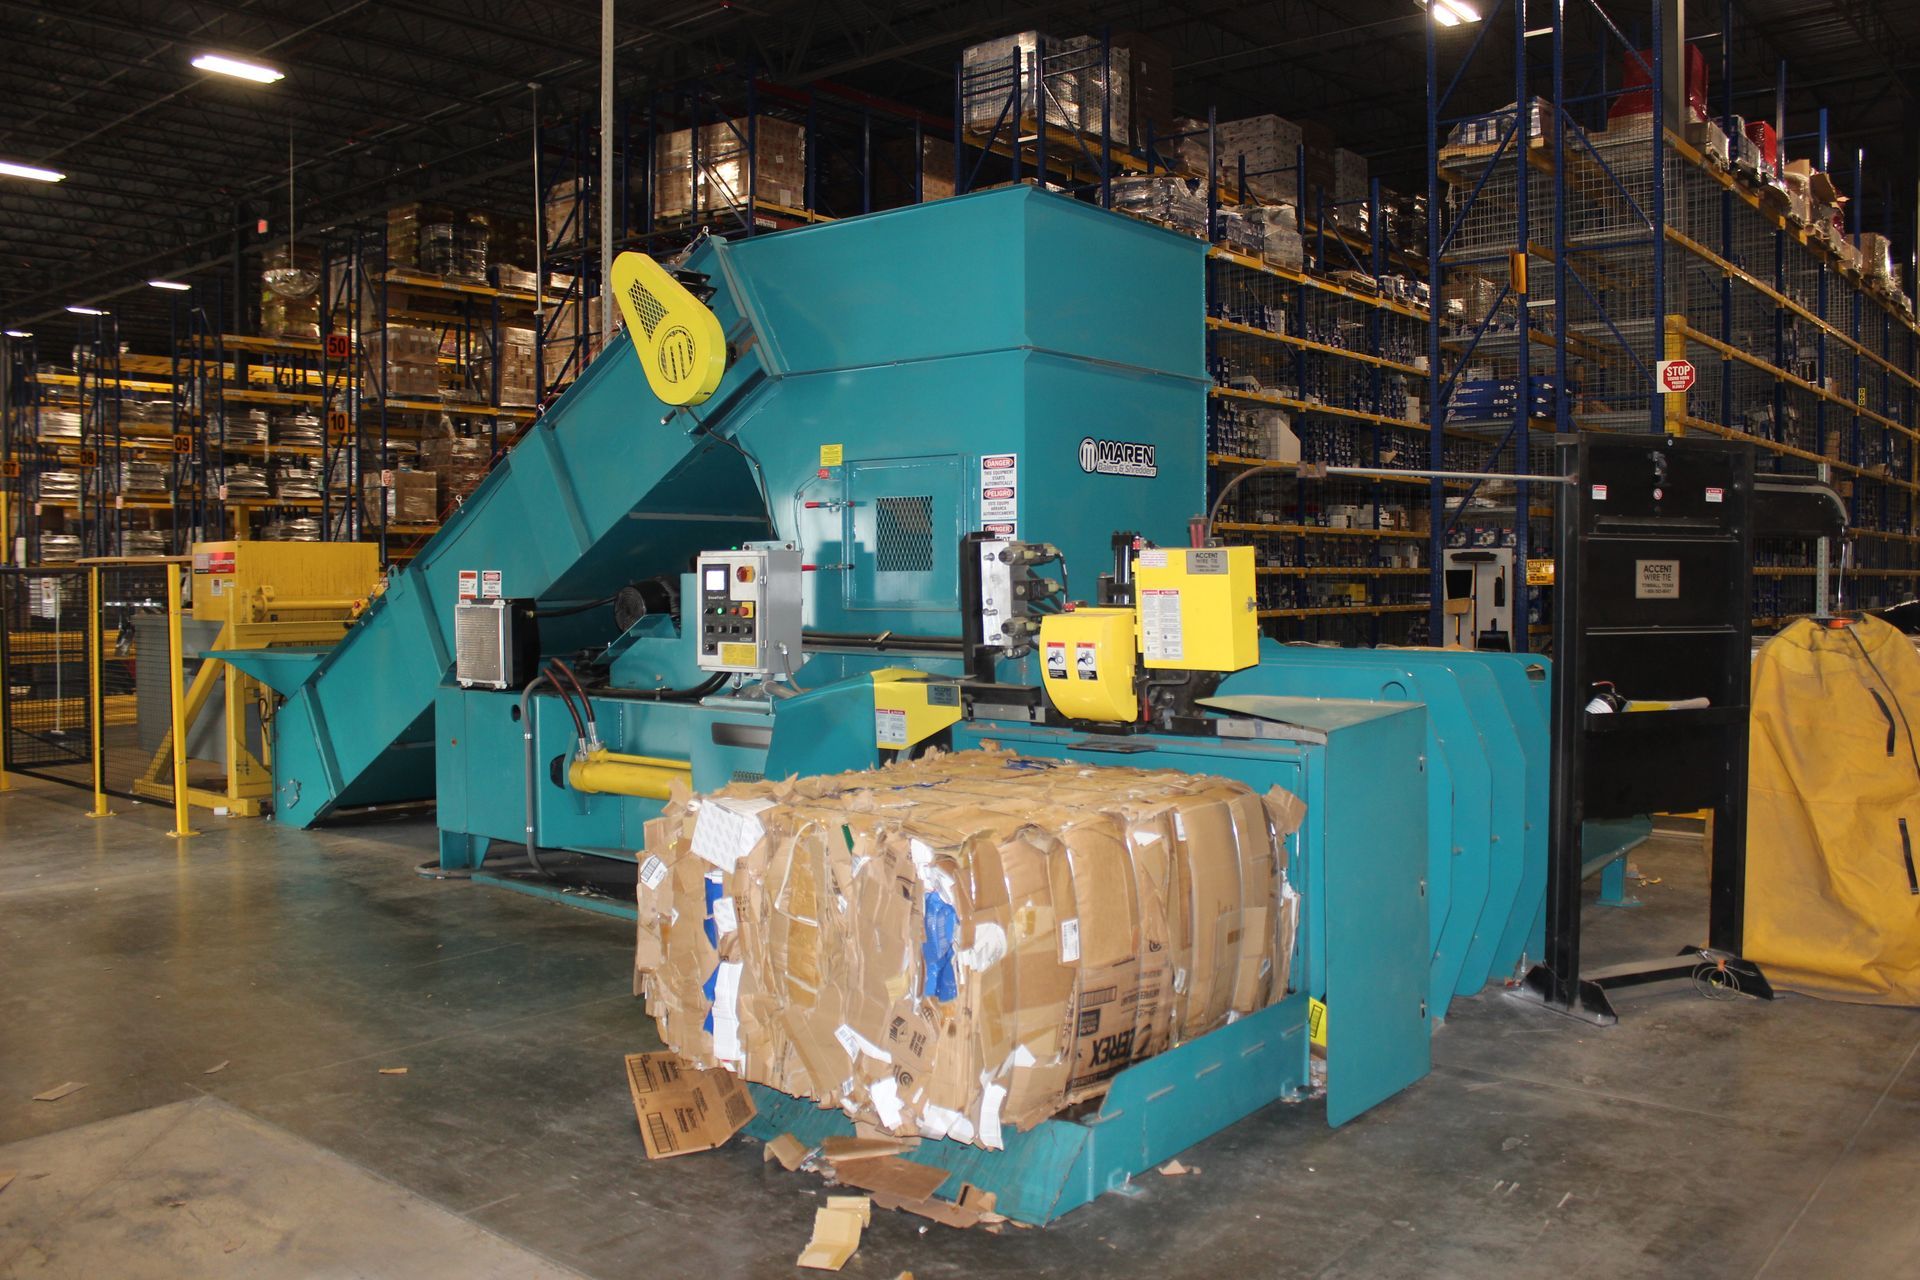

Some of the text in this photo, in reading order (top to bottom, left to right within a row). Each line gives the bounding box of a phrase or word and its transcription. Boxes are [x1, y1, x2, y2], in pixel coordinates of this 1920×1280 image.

[328, 337, 346, 354] 50
[1666, 366, 1690, 376] STOP
[330, 413, 346, 431] 10
[174, 437, 190, 452] 09
[80, 451, 95, 465] 08
[1099, 442, 1154, 465] MAREN
[988, 459, 1010, 467] DANGER
[1098, 462, 1118, 471] Balers
[1125, 465, 1155, 475] Shredders
[1644, 564, 1672, 573] ACCENT
